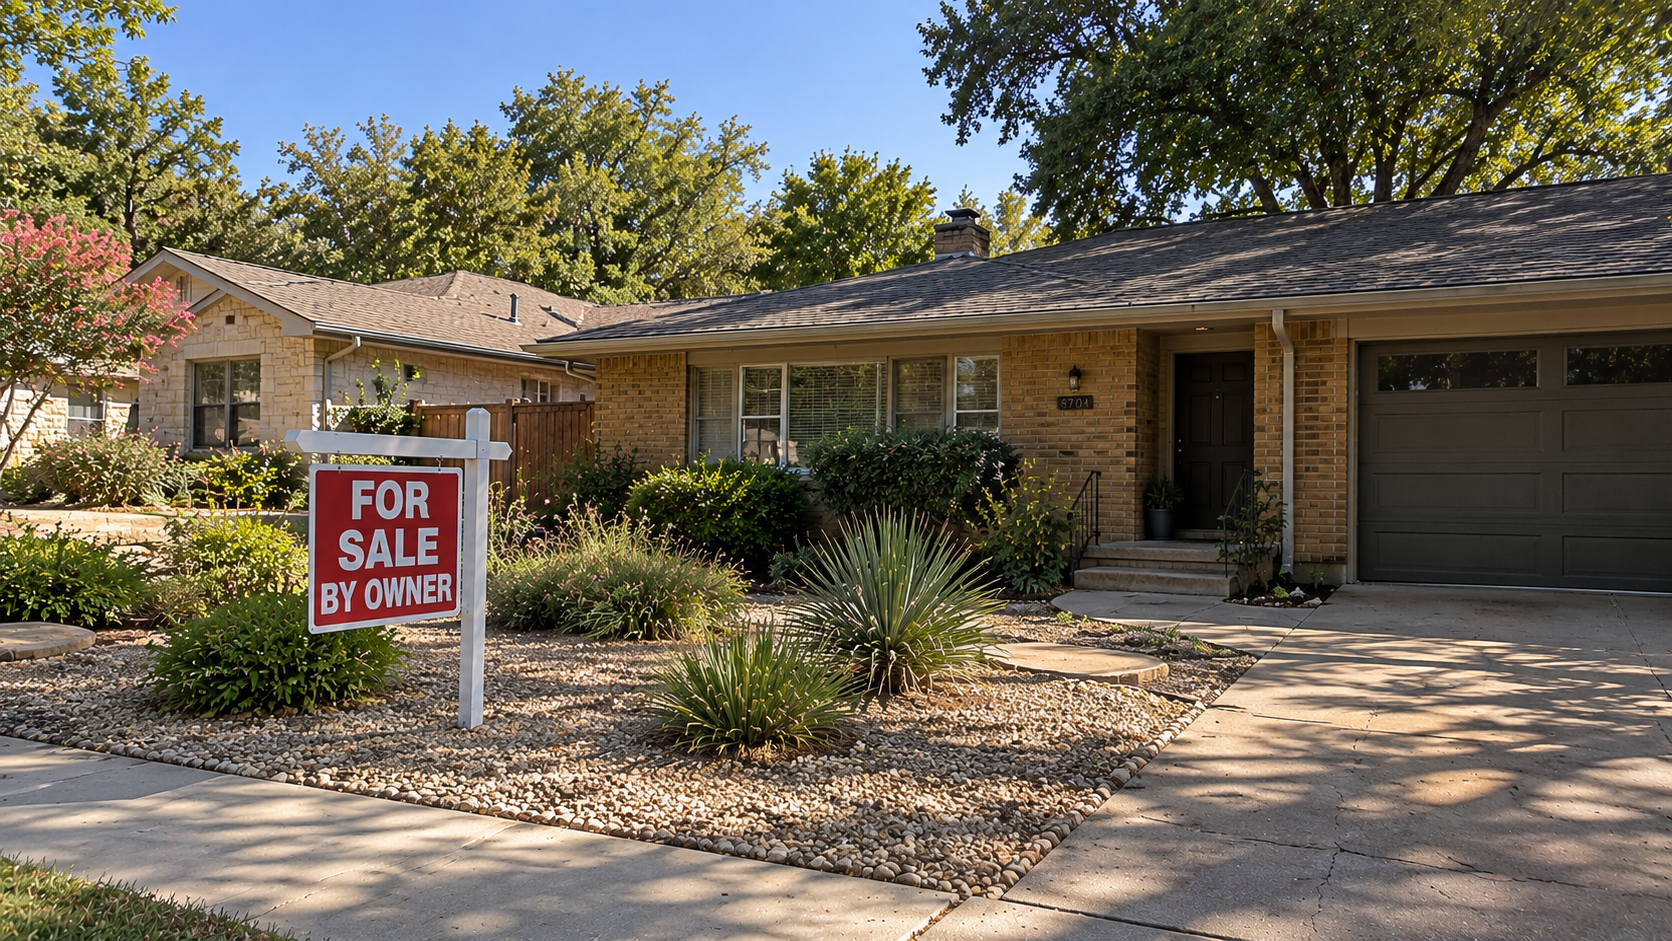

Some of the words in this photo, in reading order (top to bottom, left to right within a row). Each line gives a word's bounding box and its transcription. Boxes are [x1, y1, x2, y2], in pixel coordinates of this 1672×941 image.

[351, 479, 430, 520] FOR
[338, 527, 439, 571] SALE
[320, 580, 357, 615] BY
[364, 573, 452, 611] OWNER
